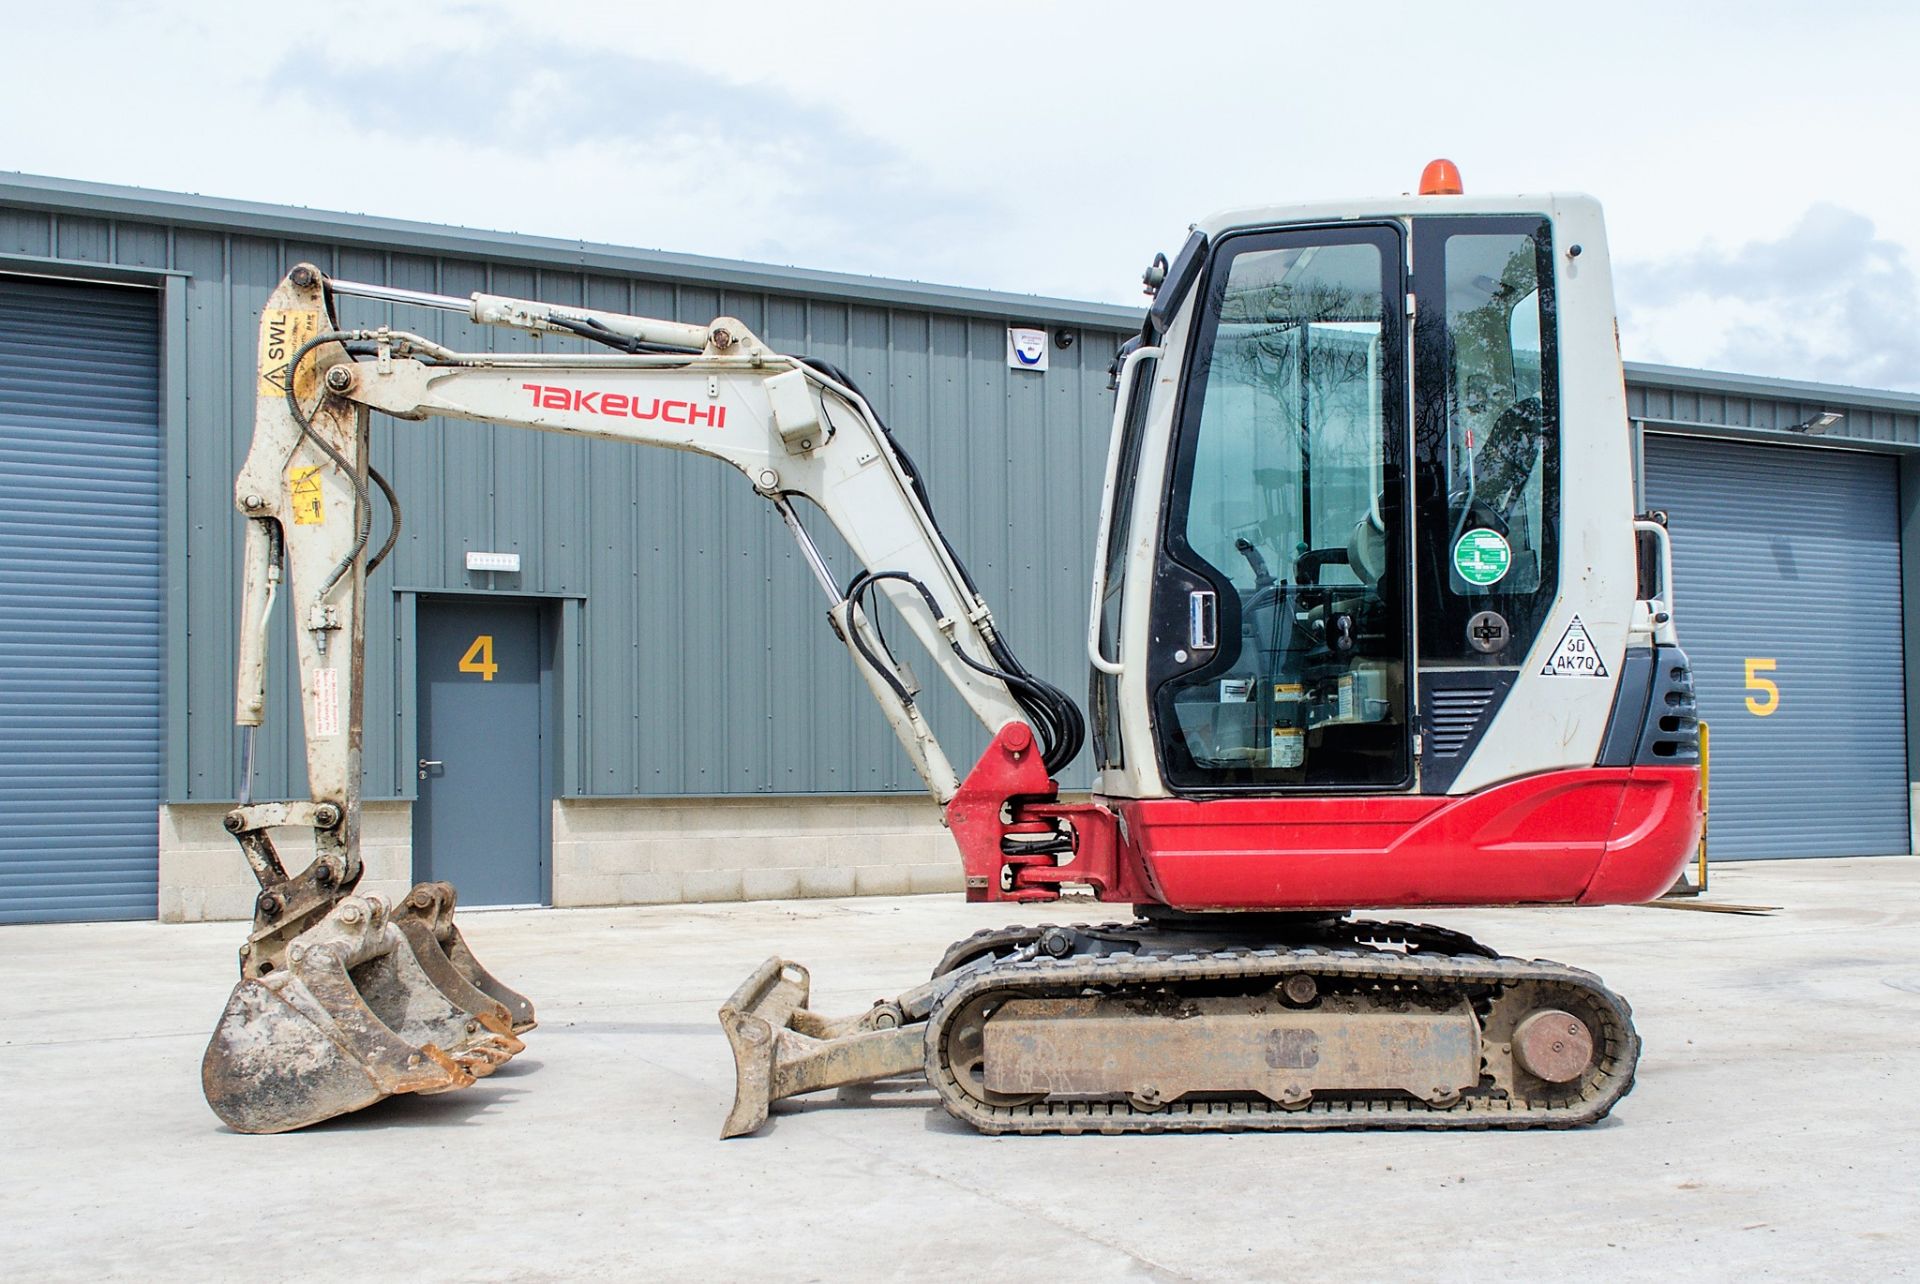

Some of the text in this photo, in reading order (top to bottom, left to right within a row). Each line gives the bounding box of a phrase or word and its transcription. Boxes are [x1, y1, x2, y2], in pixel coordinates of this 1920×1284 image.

[269, 315, 286, 360] SWL
[458, 635, 498, 681] 4
[1744, 658, 1780, 716] 5
